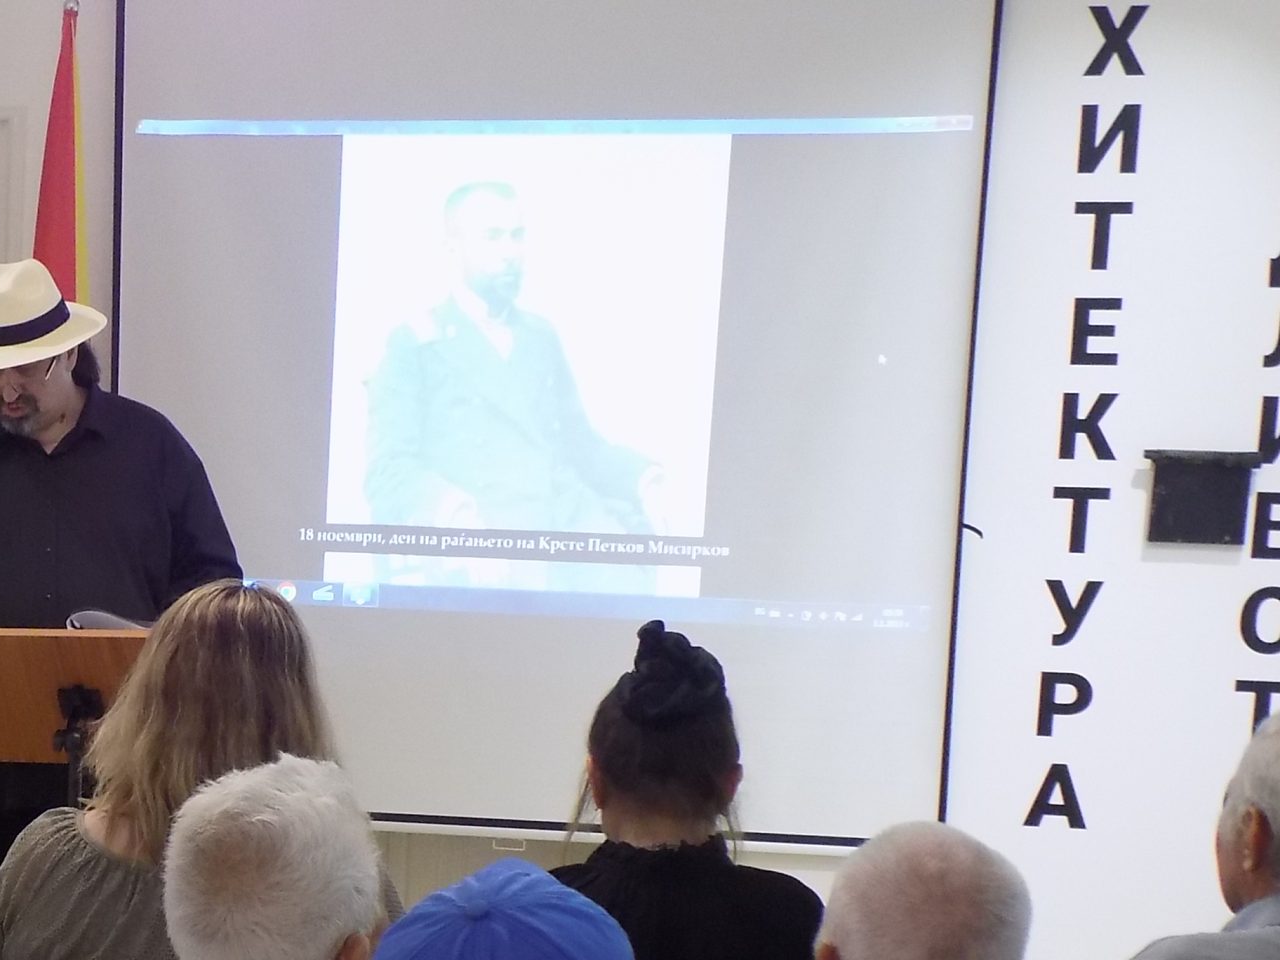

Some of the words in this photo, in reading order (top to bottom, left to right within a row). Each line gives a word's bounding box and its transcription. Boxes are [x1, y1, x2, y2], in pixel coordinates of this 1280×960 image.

[298, 528, 314, 541] 18
[388, 533, 416, 545] ден
[419, 535, 437, 545] на
[516, 538, 535, 549] на
[538, 536, 585, 554] Крсте
[588, 538, 645, 554] Петков
[648, 540, 730, 560] Мисирков
